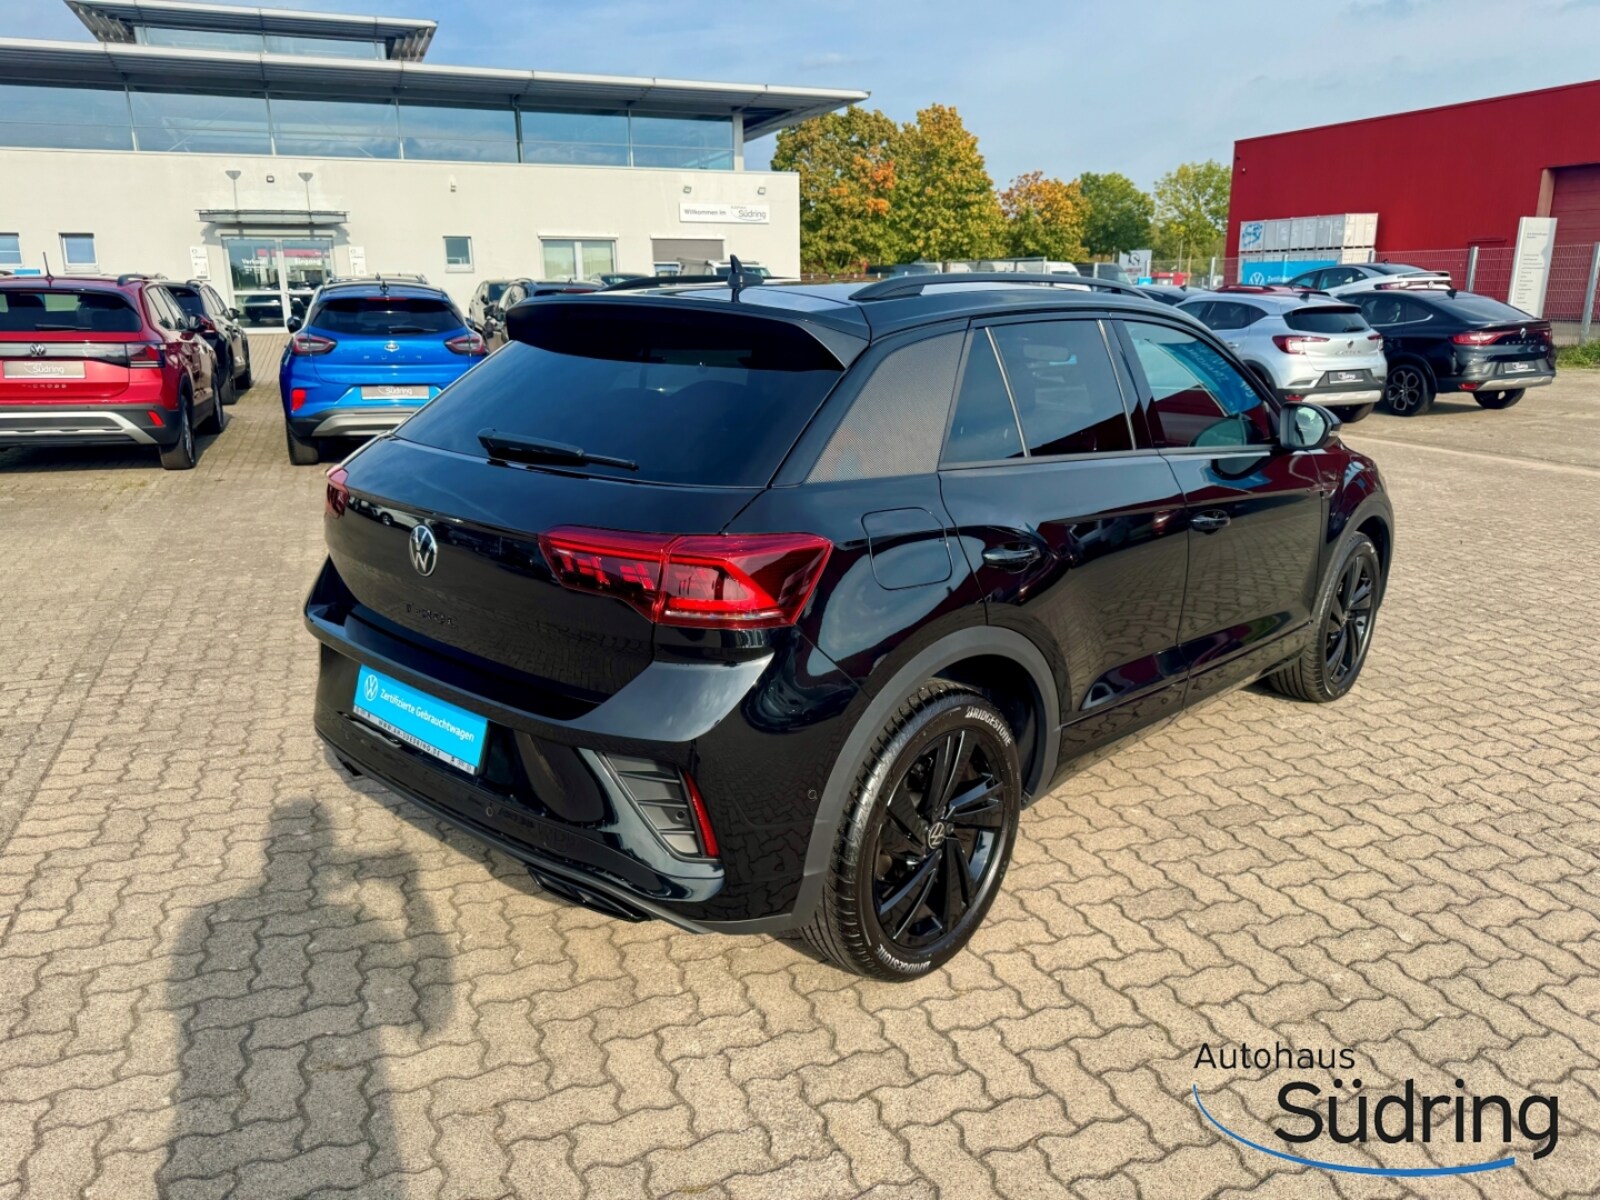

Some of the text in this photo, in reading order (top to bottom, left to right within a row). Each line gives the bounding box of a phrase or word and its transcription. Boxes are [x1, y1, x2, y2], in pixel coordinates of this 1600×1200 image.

[684, 208, 718, 216] Willkommen
[738, 209, 767, 220] Südring
[32, 364, 65, 375] Südring
[379, 688, 475, 743] Zertifizierte Gebrauchtwagen
[965, 705, 1012, 748] BRIDGESTONE
[875, 943, 932, 973] BRIDGESTONE
